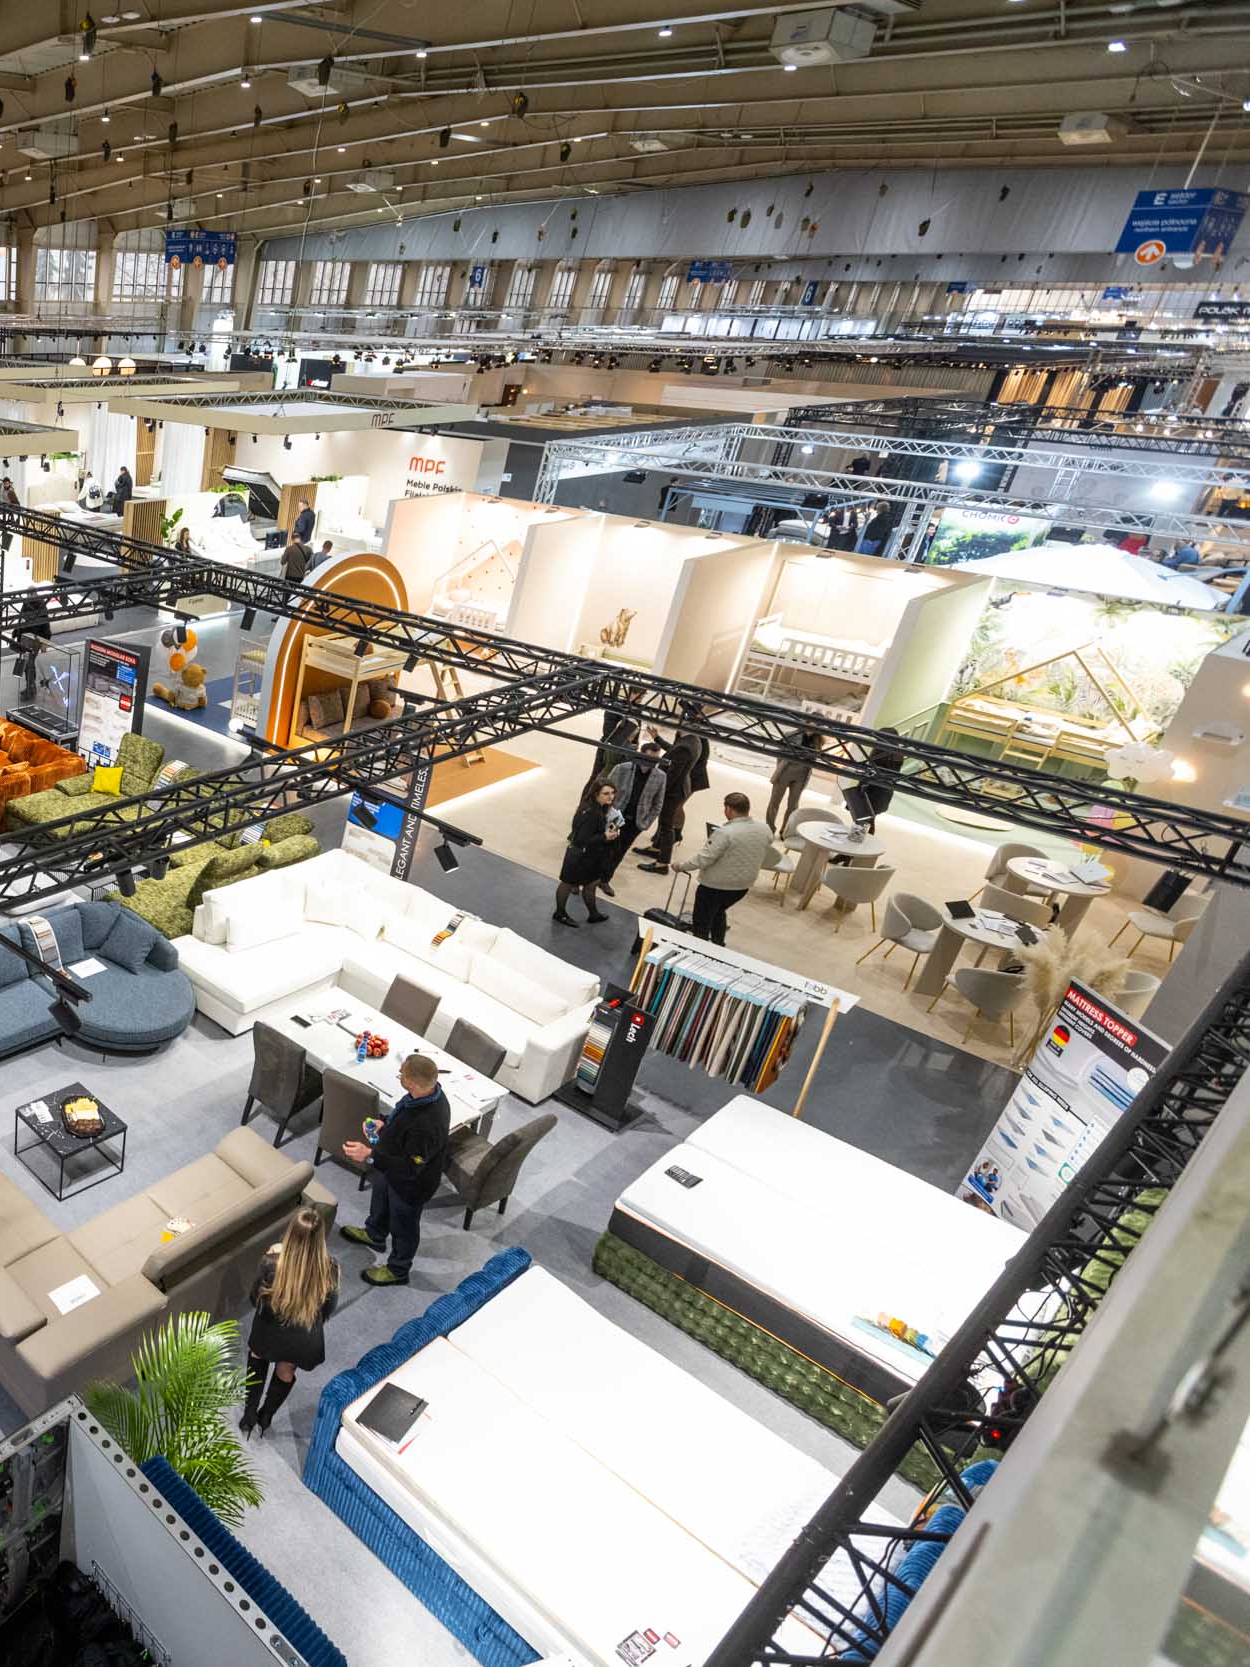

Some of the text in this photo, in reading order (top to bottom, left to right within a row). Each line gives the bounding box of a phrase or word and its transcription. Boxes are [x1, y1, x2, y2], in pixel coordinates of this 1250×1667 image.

[1153, 193, 1167, 206] E
[370, 412, 396, 428] MPF
[409, 456, 447, 475] MPF
[406, 479, 463, 493] Meble Polskie
[394, 838, 412, 881] LEGANT
[411, 767, 430, 810] TIMELES
[1066, 991, 1134, 1045] MATTRESS TOPPER
[626, 1022, 641, 1043] Lech
[1094, 1023, 1105, 1034] AND
